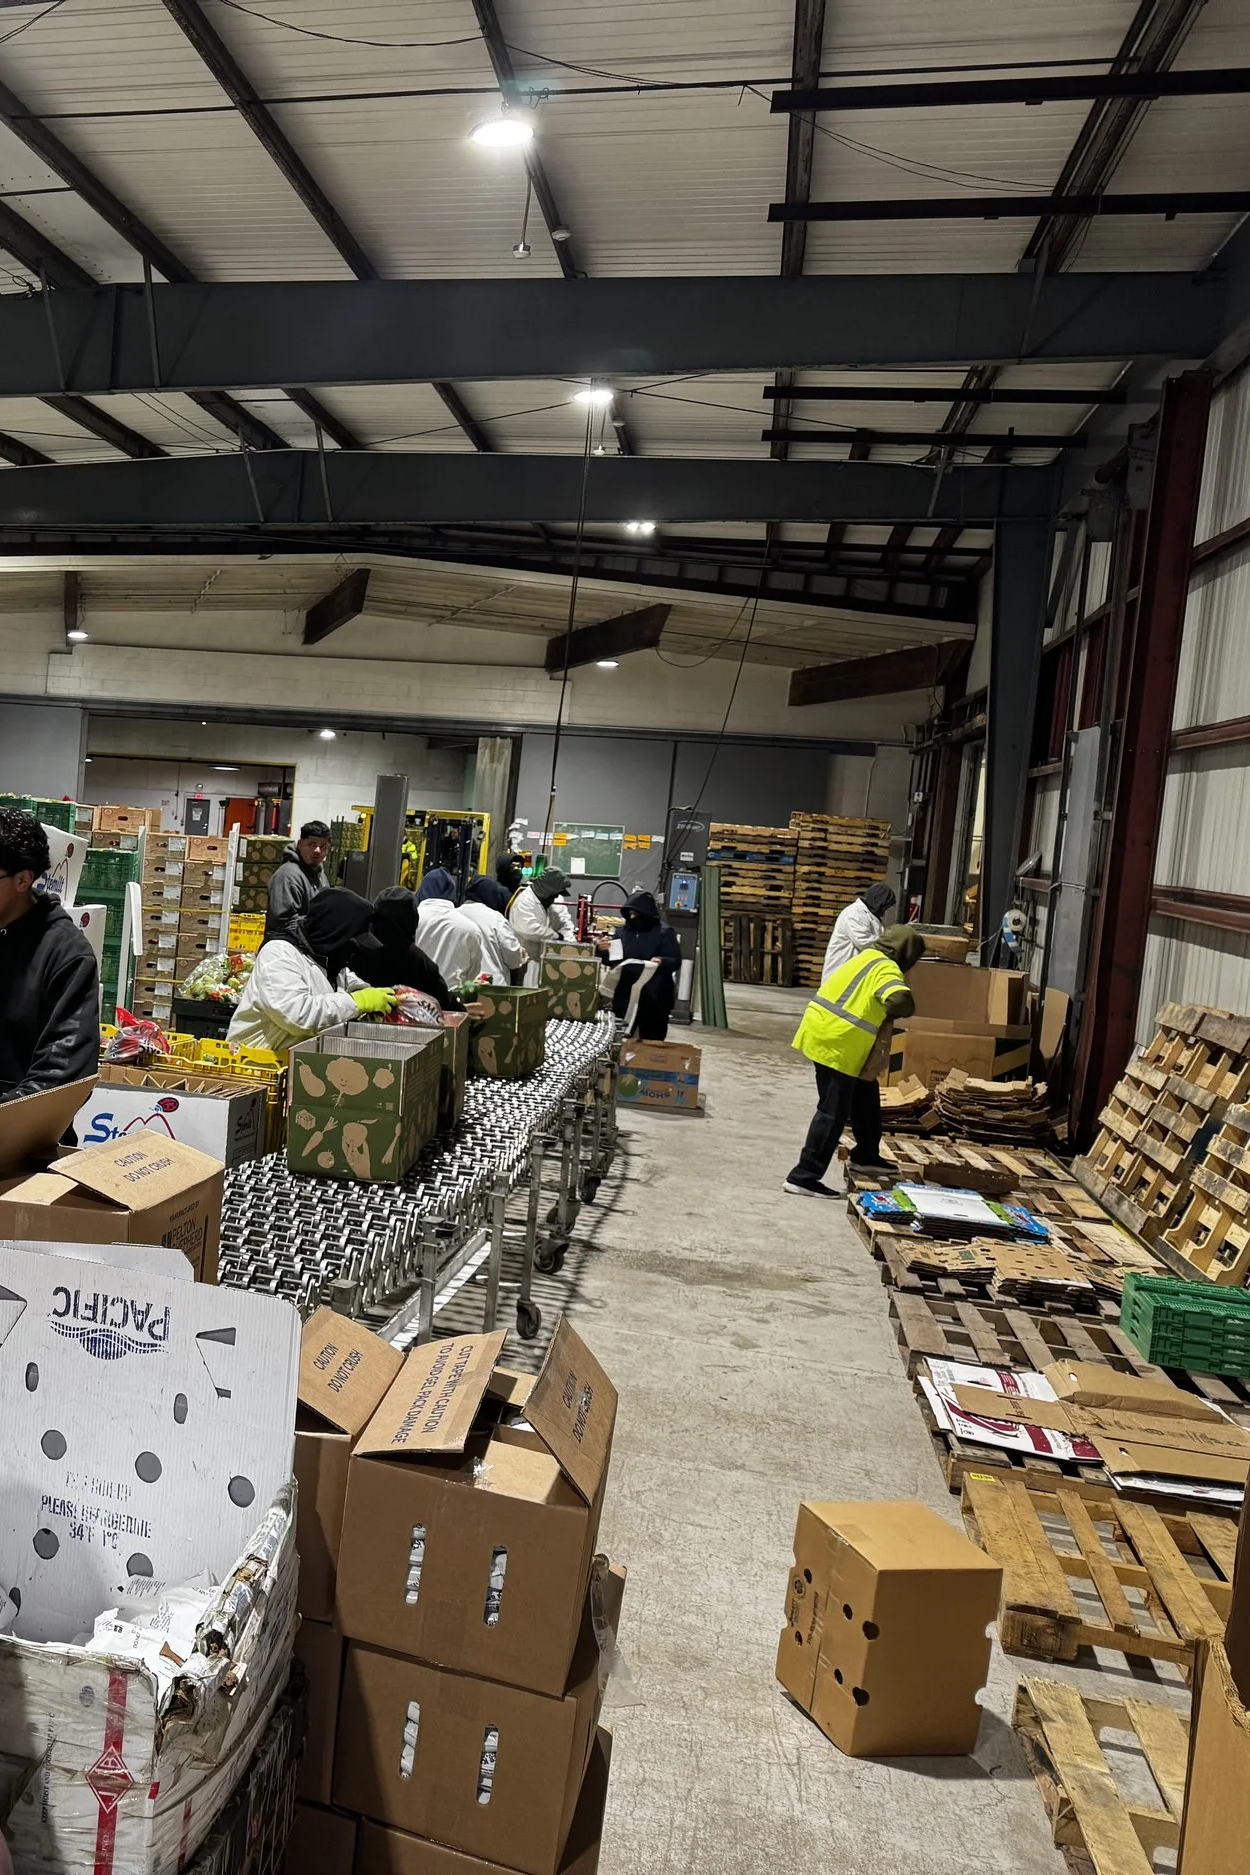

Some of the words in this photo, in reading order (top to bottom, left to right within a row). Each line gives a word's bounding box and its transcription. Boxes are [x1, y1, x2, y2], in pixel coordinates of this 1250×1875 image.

[114, 1151, 148, 1167] CAUTION
[123, 1172, 140, 1182] DO
[134, 1165, 154, 1178] NOT
[149, 1157, 176, 1171] CRUSH
[172, 1216, 197, 1240] PELTON
[52, 1286, 171, 1342] PACIFIC
[313, 1342, 339, 1370] CAUTION
[439, 1343, 455, 1354] TO
[457, 1345, 474, 1360] CUT
[342, 1348, 364, 1371] CRUSH
[429, 1355, 450, 1376] AVOID
[448, 1360, 468, 1380] TAPE
[327, 1378, 343, 1393] DO
[334, 1366, 351, 1385] NOT
[421, 1376, 439, 1391] GEL
[439, 1378, 460, 1399] WITH
[562, 1368, 578, 1409] CAUTION
[409, 1390, 433, 1411] PACK
[421, 1398, 451, 1434] CAUTION
[576, 1406, 588, 1431] NOT
[391, 1410, 422, 1444] DAMAGE
[572, 1422, 584, 1444] DO
